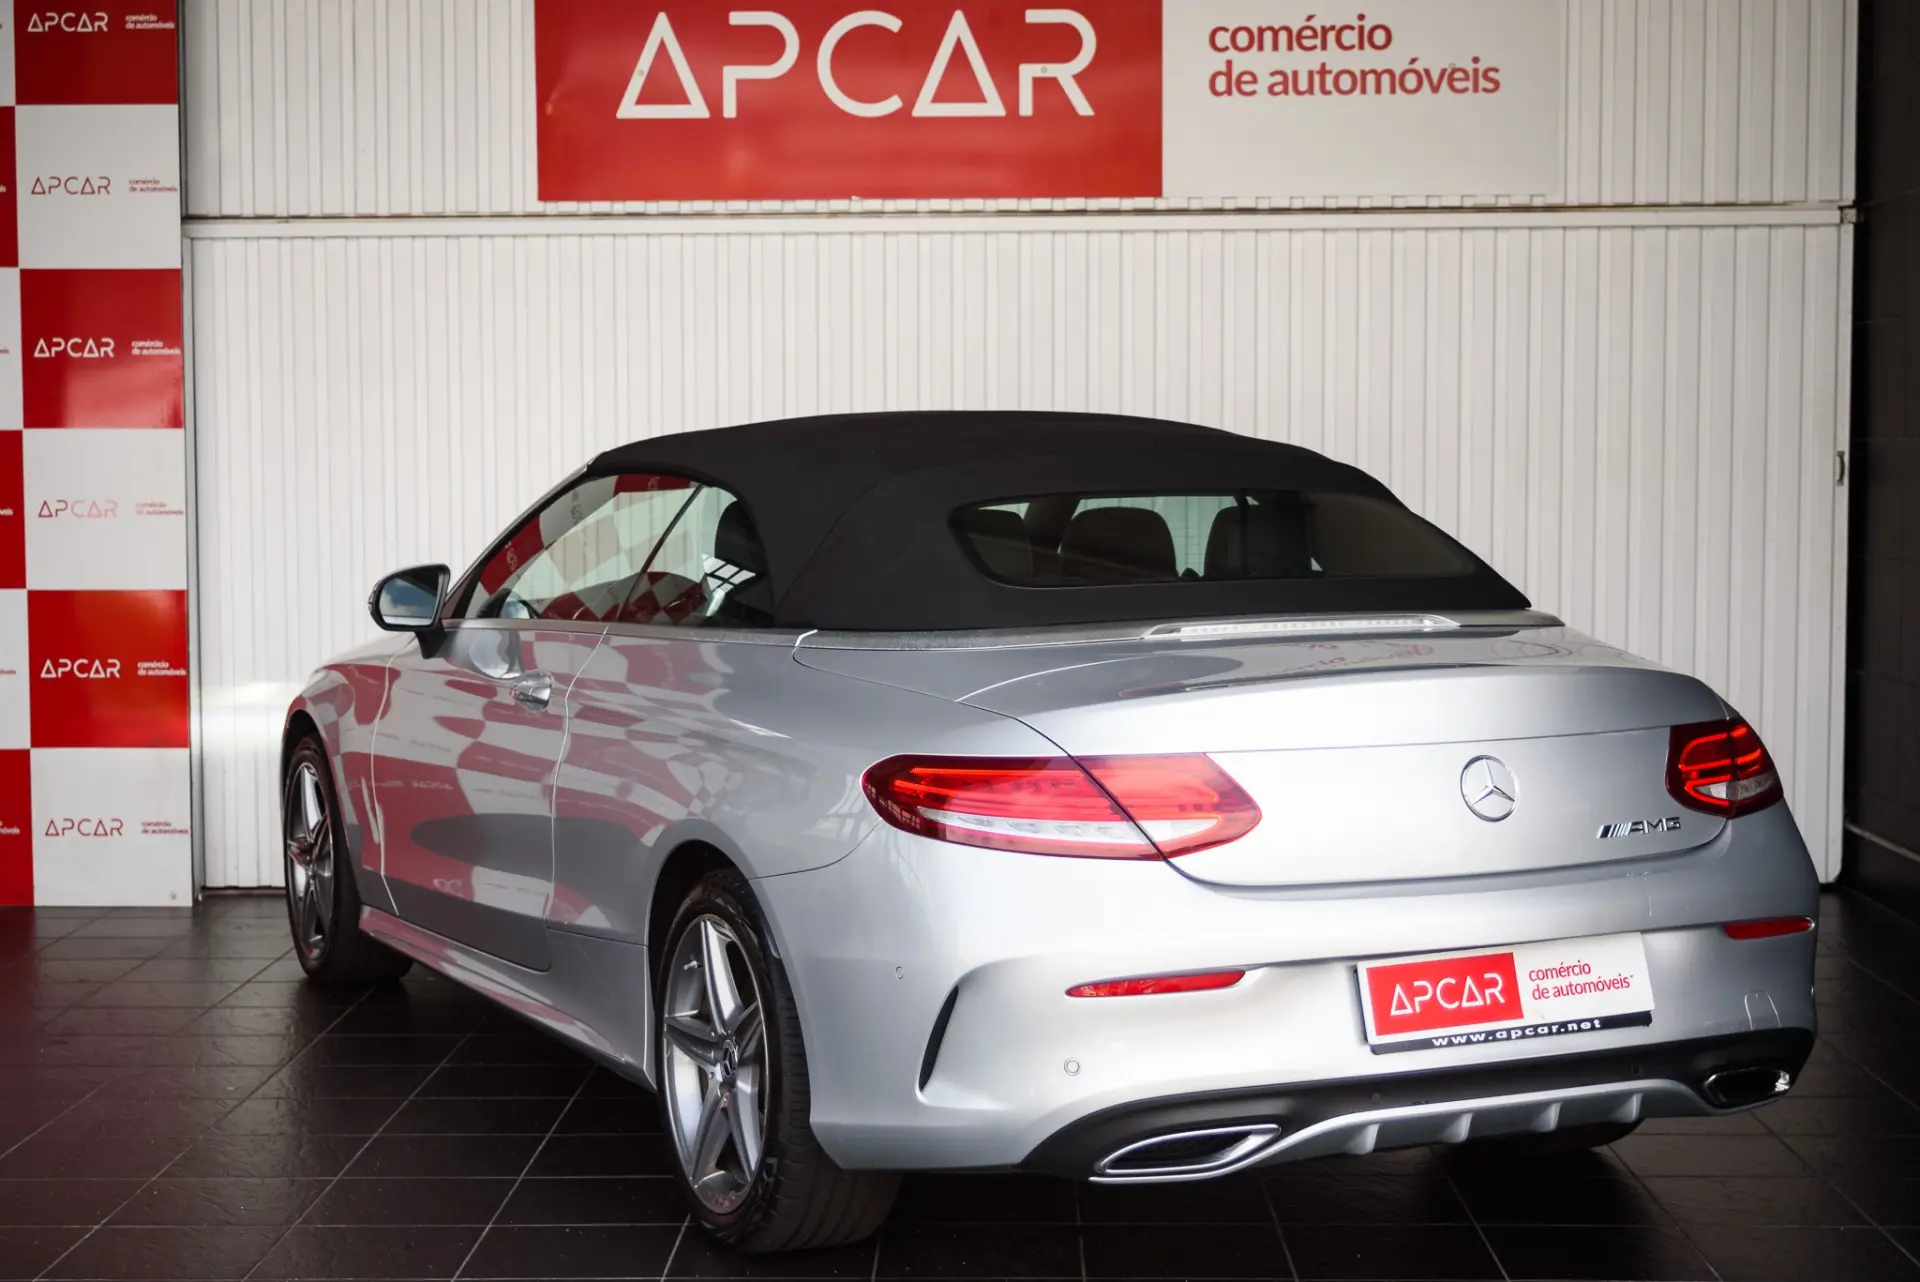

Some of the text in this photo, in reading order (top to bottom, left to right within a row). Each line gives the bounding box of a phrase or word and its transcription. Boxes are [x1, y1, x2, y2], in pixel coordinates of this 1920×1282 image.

[28, 12, 108, 32] APCAR
[1208, 13, 1393, 52] comércio
[616, 9, 1096, 119] APCAR
[1208, 60, 1501, 97] de automóveis
[31, 176, 111, 195] APCAR
[34, 337, 115, 358] APCAR
[38, 500, 118, 518] APCAR
[40, 659, 121, 678] APCAR
[45, 818, 123, 837] APCAR
[1628, 817, 1681, 834] AMG
[1528, 961, 1591, 982] comércio
[1390, 972, 1505, 1016] APCAR
[1532, 973, 1630, 1000] de automóveis
[1431, 1018, 1603, 1047] www.apcar.net
